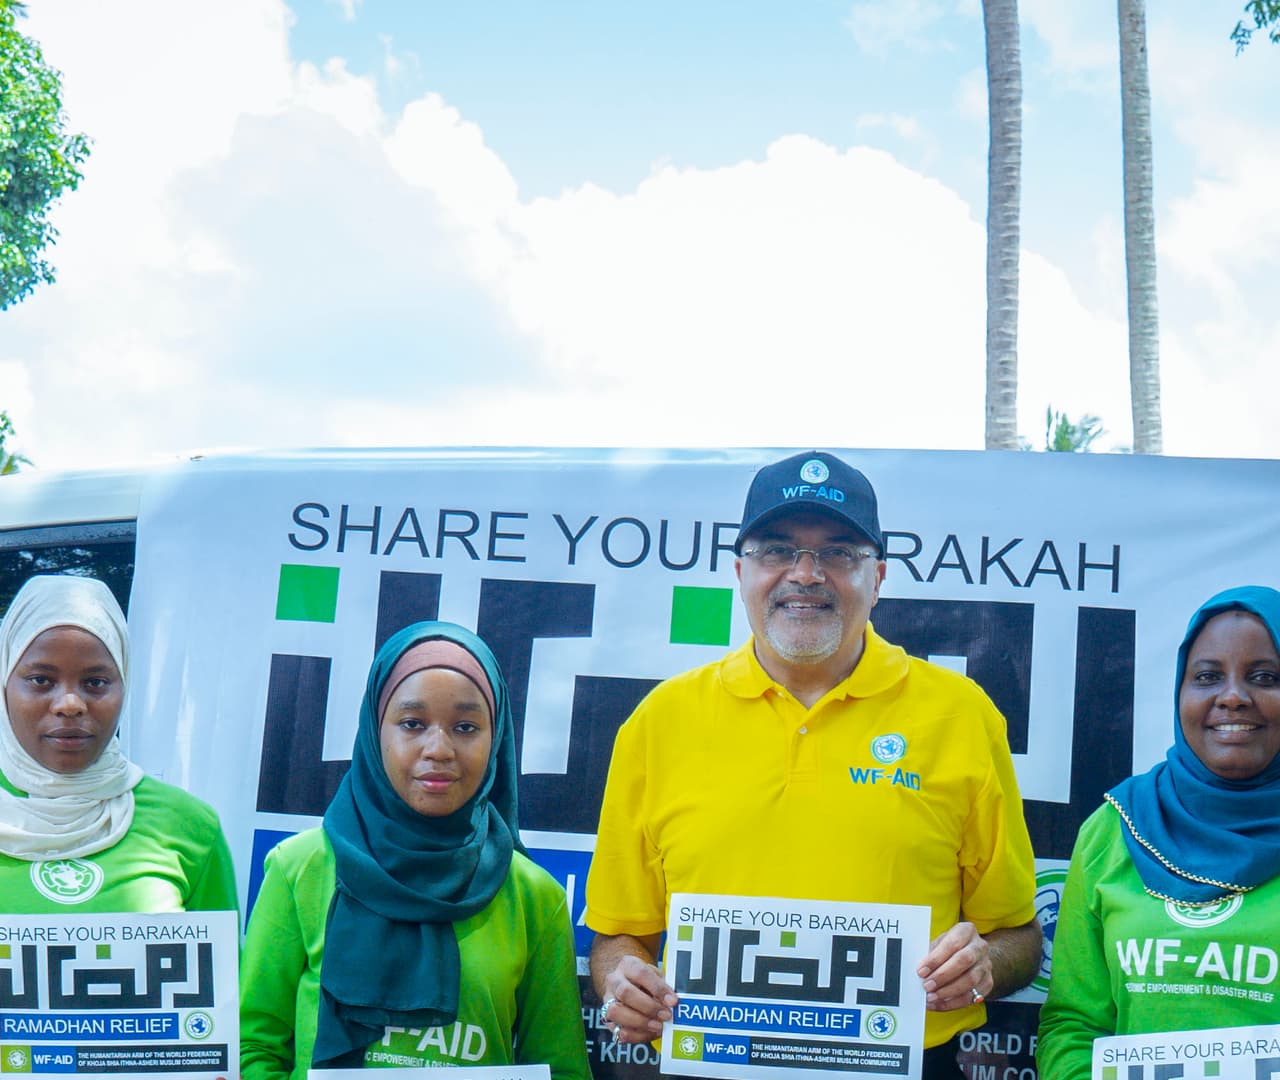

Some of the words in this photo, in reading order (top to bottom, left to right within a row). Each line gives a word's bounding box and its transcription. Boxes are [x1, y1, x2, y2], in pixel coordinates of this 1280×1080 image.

[782, 484, 844, 504] WF-AID
[288, 502, 528, 563] SHARE
[883, 530, 1121, 593] RAKAH
[849, 766, 921, 791] WF-AID
[679, 906, 742, 925] SHARE
[749, 910, 802, 928] YOUR
[809, 914, 899, 934] BARAKAH
[64, 926, 116, 942] YOUR
[122, 924, 208, 941] BARAKAH
[1116, 938, 1278, 985] WF-AID
[1147, 984, 1204, 994] EMPOWERMENT
[1212, 986, 1247, 998] DISASTER
[1248, 990, 1274, 1002] RELIEF
[4, 1018, 105, 1034] RAMADHAN
[112, 1018, 172, 1033] RELIEF
[678, 1003, 783, 1026] RAMADHAN
[788, 1010, 854, 1029] RELIEF
[382, 1021, 487, 1061] F-AID
[706, 1042, 747, 1056] WF-AID
[960, 1031, 1022, 1055] ORLD
[1102, 1046, 1166, 1064] SHARE
[1170, 1042, 1224, 1060] YOUR
[34, 1055, 73, 1065] WF-AID
[600, 1041, 661, 1067] KHOJ
